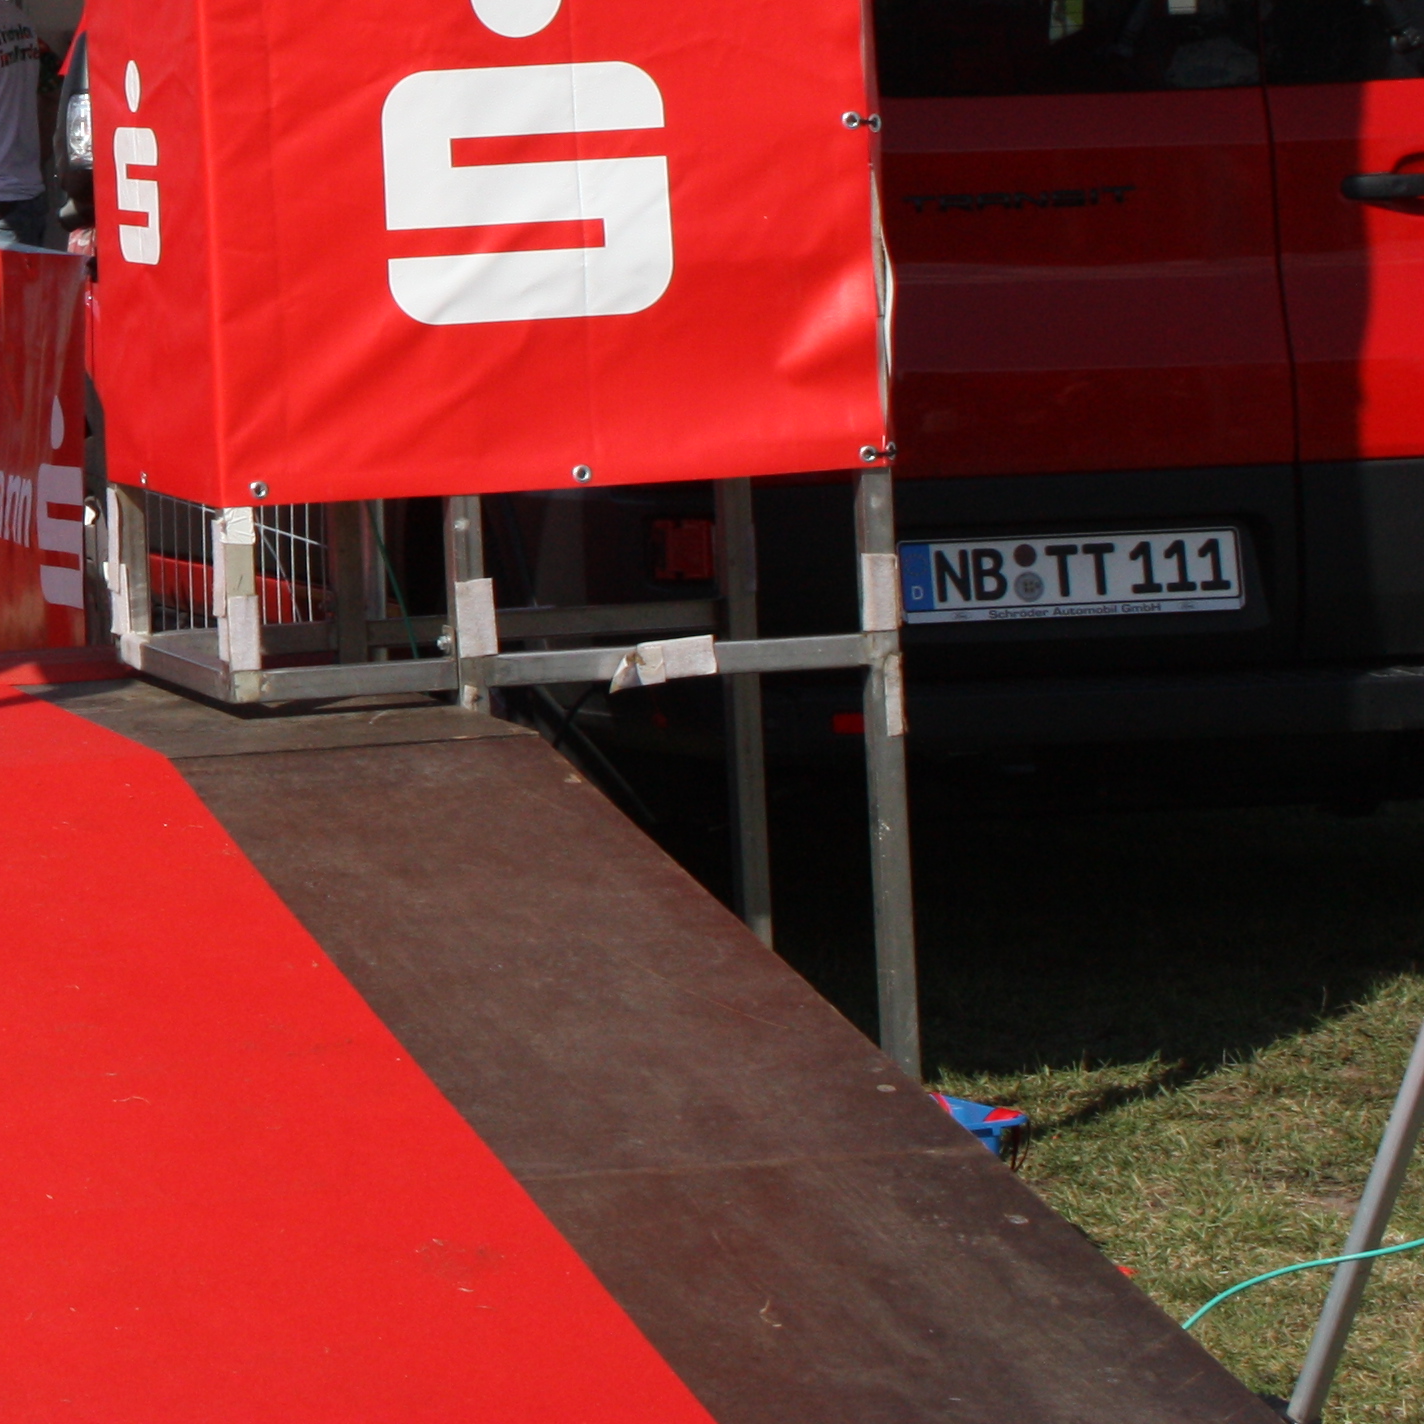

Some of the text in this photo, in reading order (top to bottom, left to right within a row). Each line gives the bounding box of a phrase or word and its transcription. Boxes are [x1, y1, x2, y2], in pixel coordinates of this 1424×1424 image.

[903, 185, 1136, 213] TRANSIT
[934, 538, 1231, 603] NB TT 111
[911, 585, 924, 601] D
[1052, 605, 1118, 617] Automobil
[1121, 602, 1162, 614] GmbH
